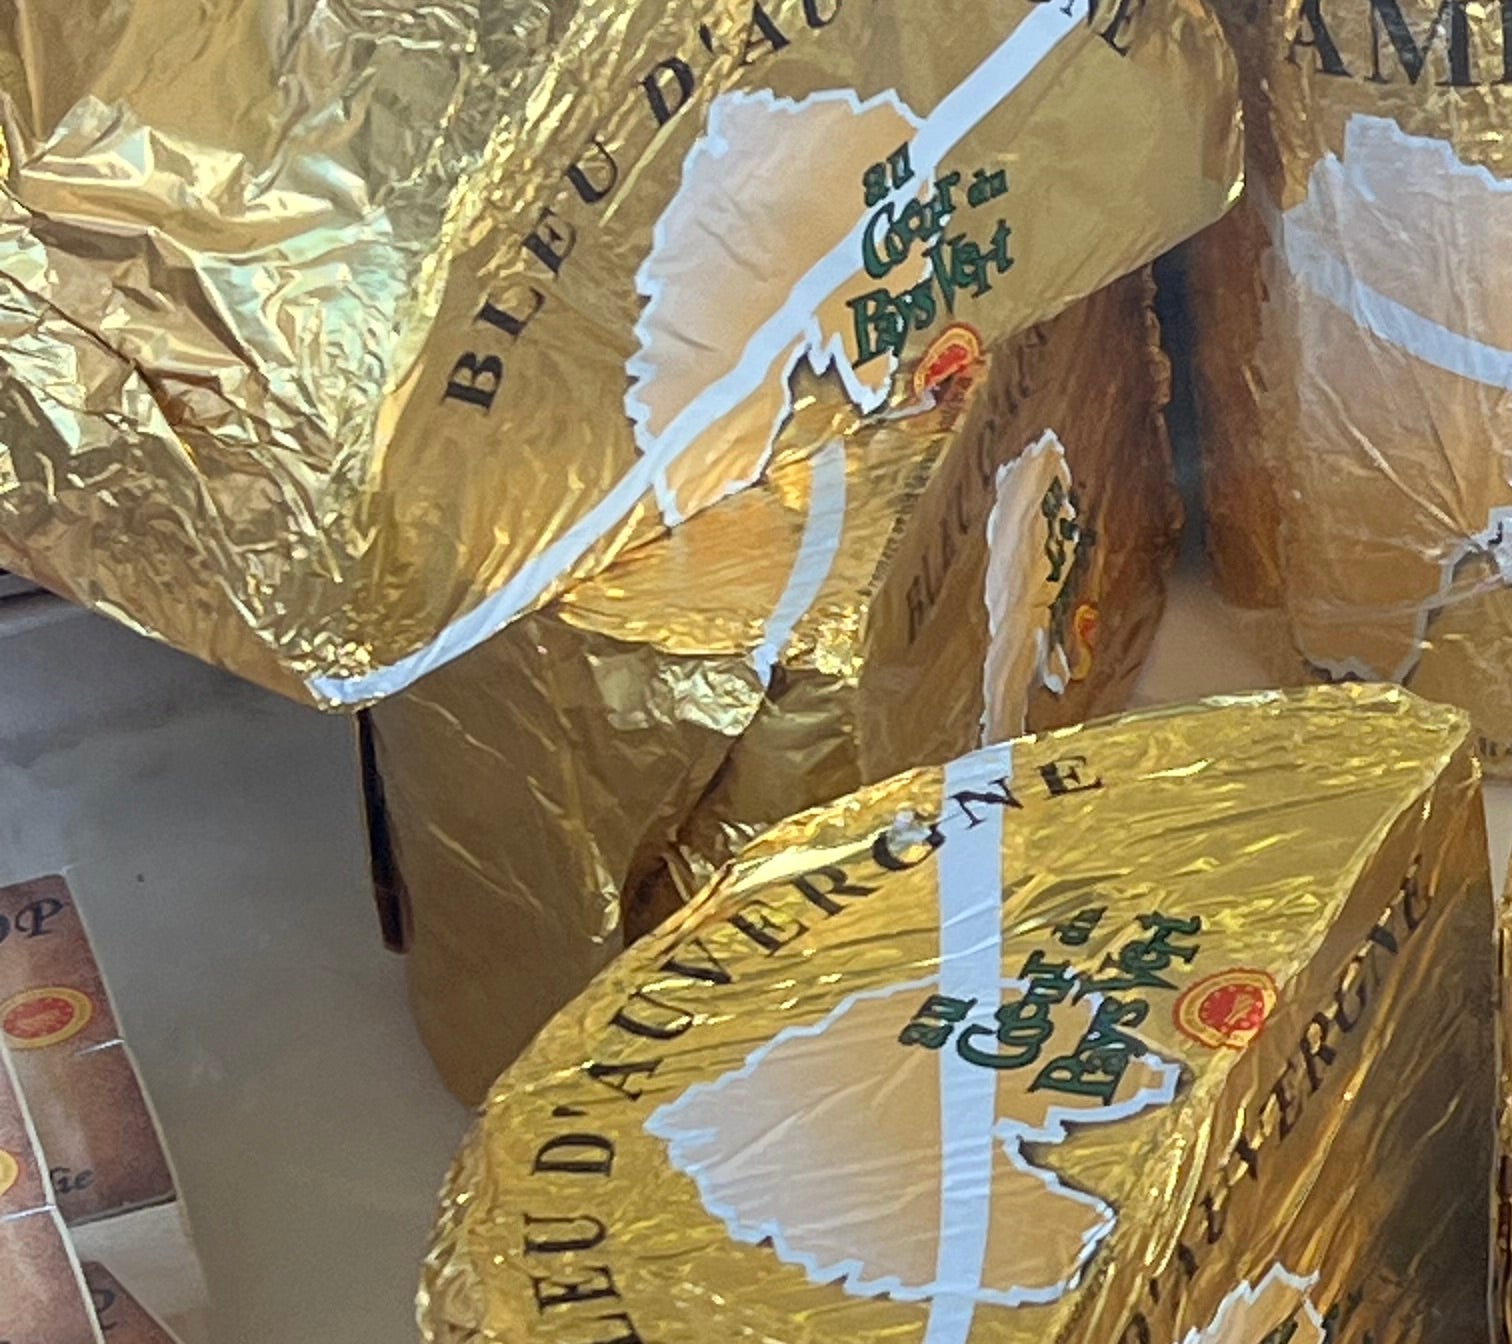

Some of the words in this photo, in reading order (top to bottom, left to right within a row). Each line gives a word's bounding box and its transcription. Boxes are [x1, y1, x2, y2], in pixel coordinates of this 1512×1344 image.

[862, 141, 916, 209] au
[966, 166, 1010, 209] du
[440, 138, 620, 418] BLEU
[845, 276, 938, 371] Pays
[921, 217, 1016, 316] Vert
[529, 753, 1107, 1181] D'AUVERGNE
[1070, 910, 1203, 1007] Vert
[897, 993, 978, 1049] au
[1026, 996, 1151, 1107] Pays
